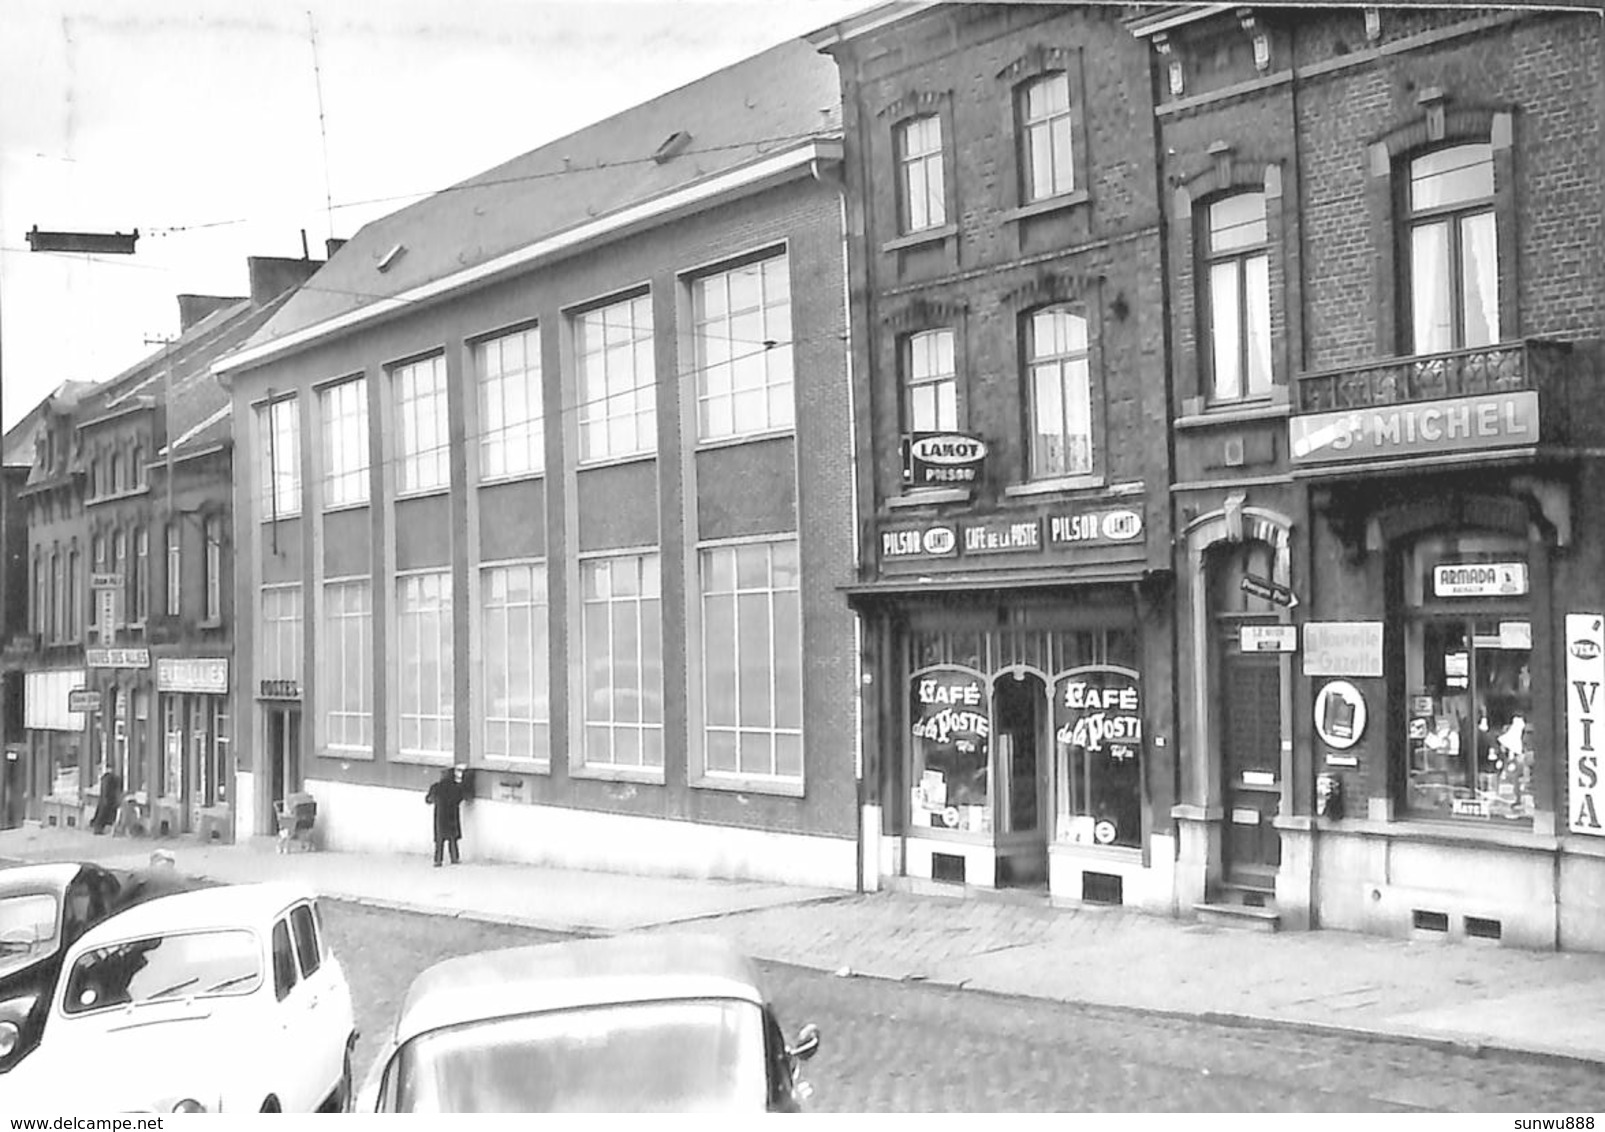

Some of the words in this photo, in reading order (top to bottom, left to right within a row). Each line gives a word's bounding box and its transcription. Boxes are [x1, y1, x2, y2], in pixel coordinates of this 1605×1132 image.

[1373, 400, 1528, 446] MICHEL
[921, 443, 976, 457] LAMOT
[987, 532, 999, 549] DE
[999, 532, 1010, 548] LA
[1011, 522, 1037, 547] POSTE
[1052, 514, 1098, 542] PILSOR
[883, 530, 921, 556] PILSOR
[1440, 567, 1497, 585] ARMADA
[261, 680, 298, 697] POSTES
[919, 679, 981, 705] CAFÉ
[1065, 682, 1138, 710] CAFÉ
[1572, 680, 1602, 829] VISA
